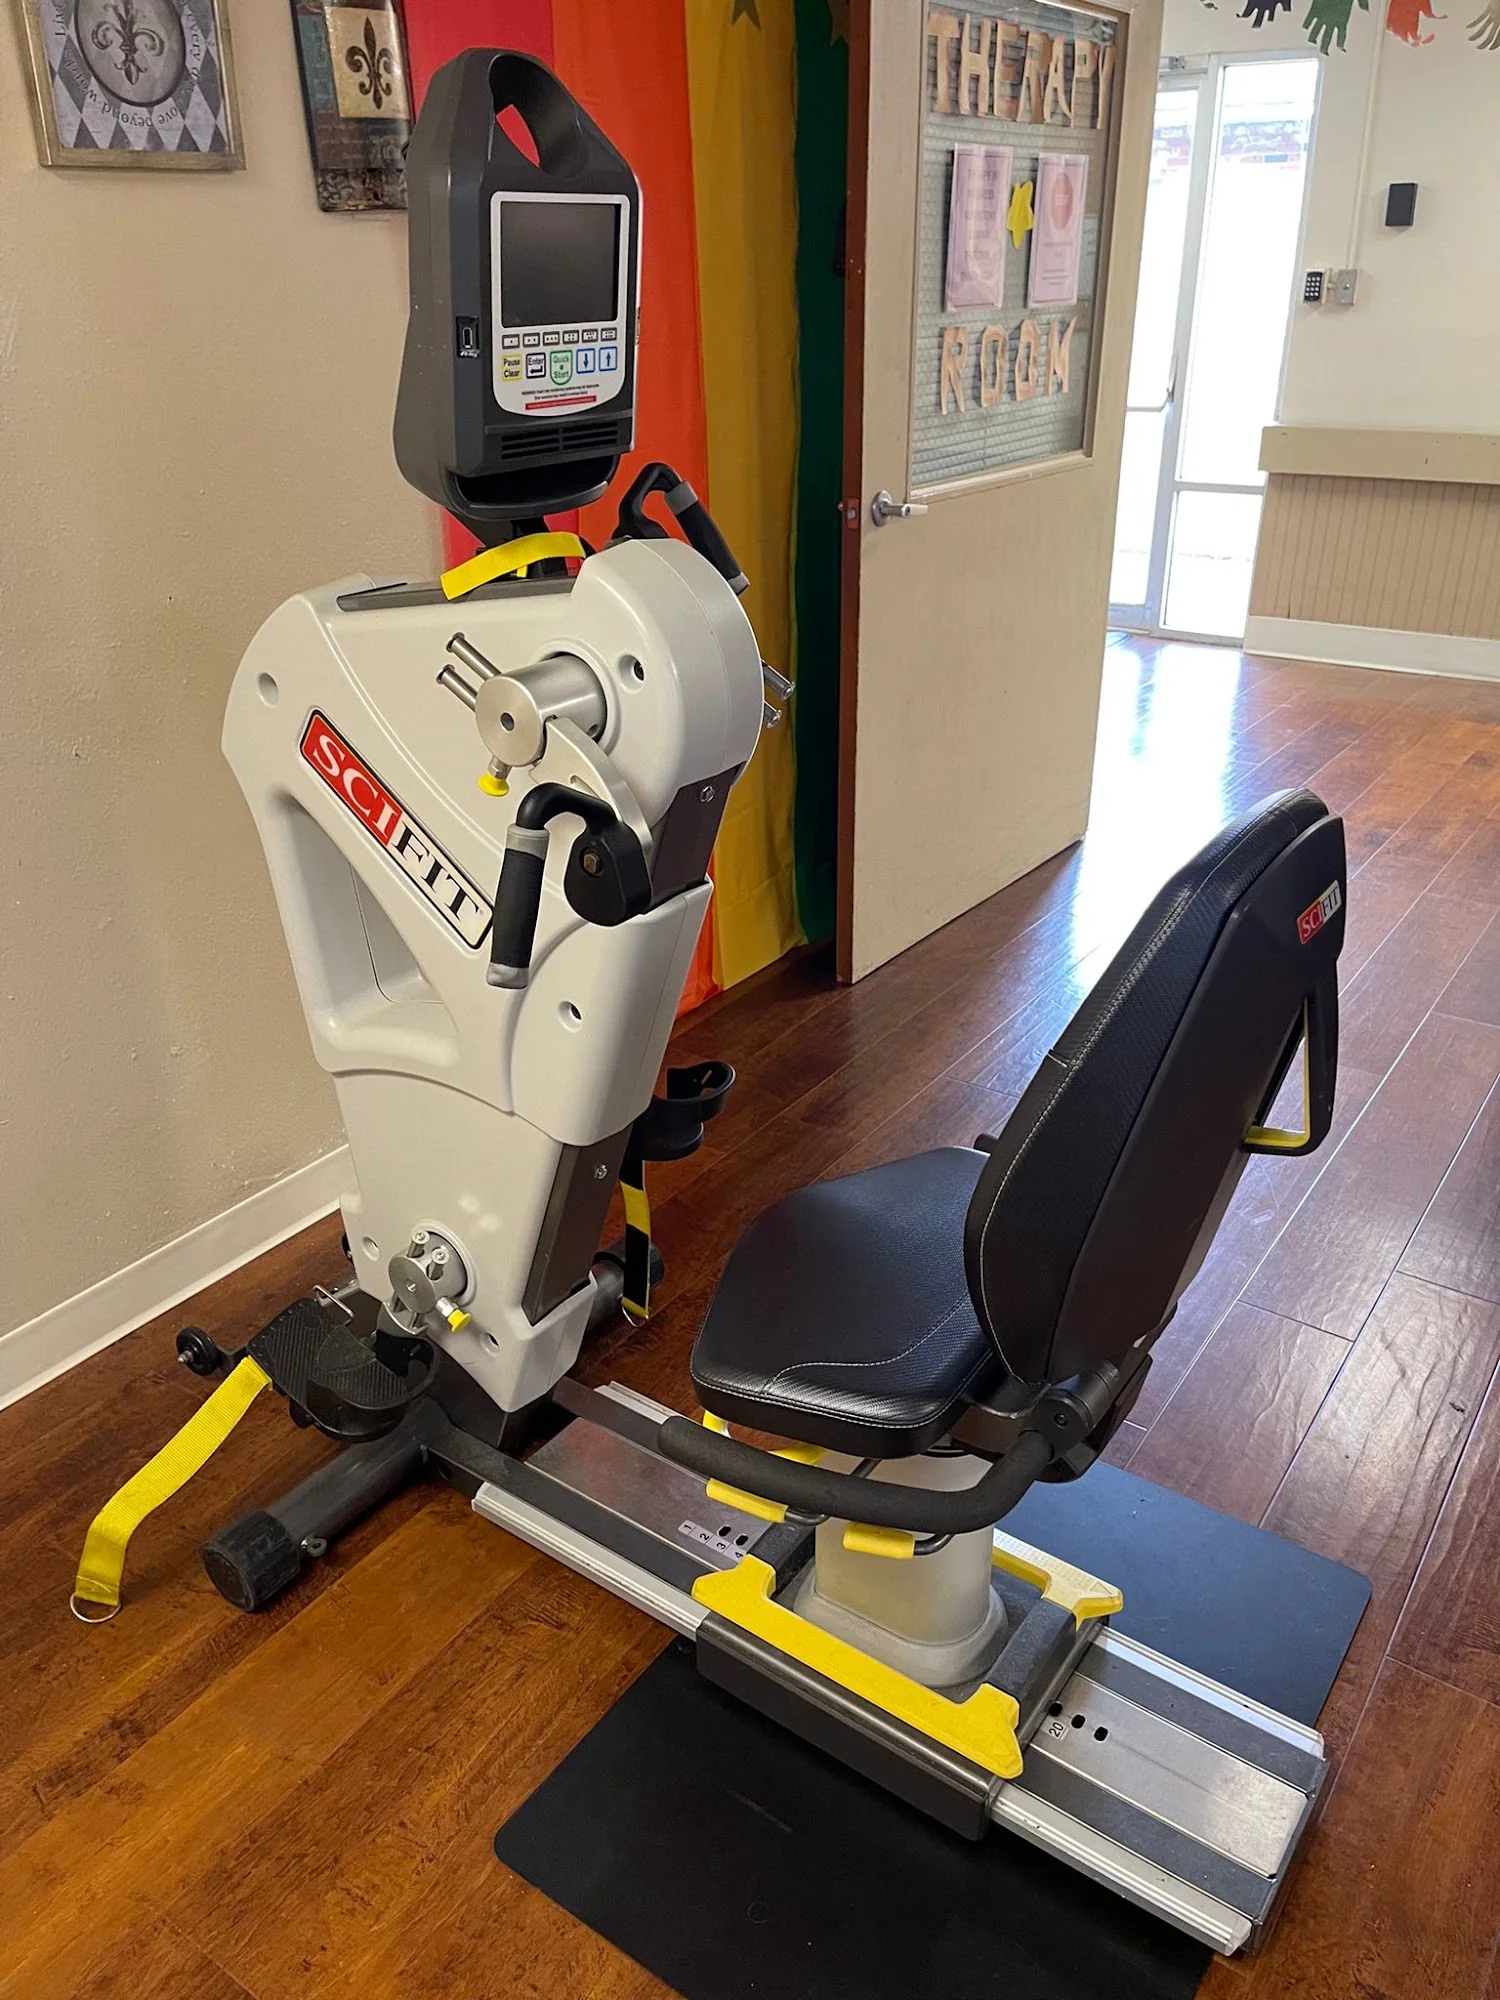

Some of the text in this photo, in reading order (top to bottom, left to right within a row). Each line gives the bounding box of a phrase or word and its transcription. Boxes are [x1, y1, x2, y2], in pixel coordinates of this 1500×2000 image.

[928, 11, 1116, 129] THERAPY
[503, 358, 520, 367] Pause
[528, 357, 544, 366] Enter
[553, 355, 569, 364] Quick
[941, 316, 1077, 415] ROOM
[504, 370, 520, 378] Clear
[553, 370, 569, 379] Start
[312, 734, 480, 921] SCIFIT
[1302, 886, 1338, 937] SCIFIT
[699, 1533, 710, 1541] 2
[716, 1542, 726, 1550] 3
[735, 1551, 744, 1559] 4
[1048, 1722, 1064, 1738] 20
